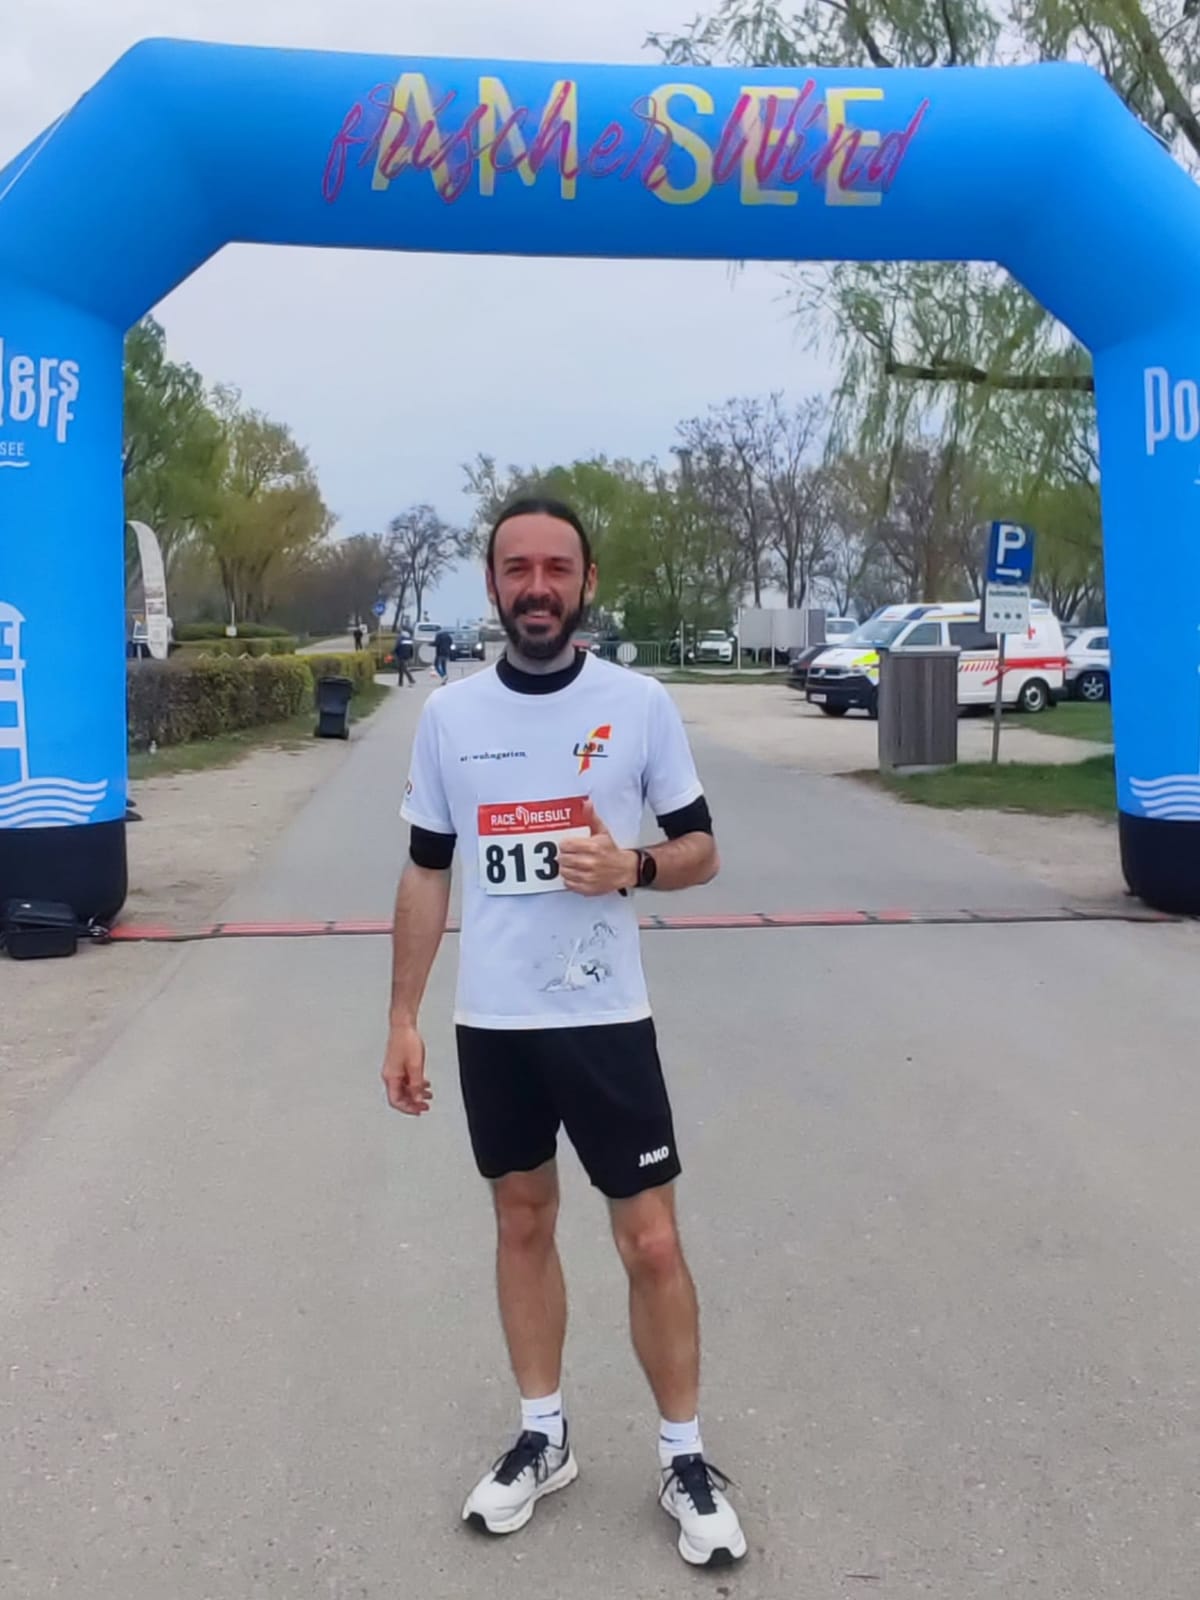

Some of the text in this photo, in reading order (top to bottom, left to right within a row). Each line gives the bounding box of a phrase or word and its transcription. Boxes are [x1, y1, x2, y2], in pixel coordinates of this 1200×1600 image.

[371, 72, 885, 206] AM SEE
[0, 337, 80, 401] ers
[997, 524, 1026, 565] P
[491, 814, 516, 826] RACE
[530, 807, 572, 824] RESULT
[486, 840, 560, 884] 813
[638, 1145, 669, 1167] JAKO
